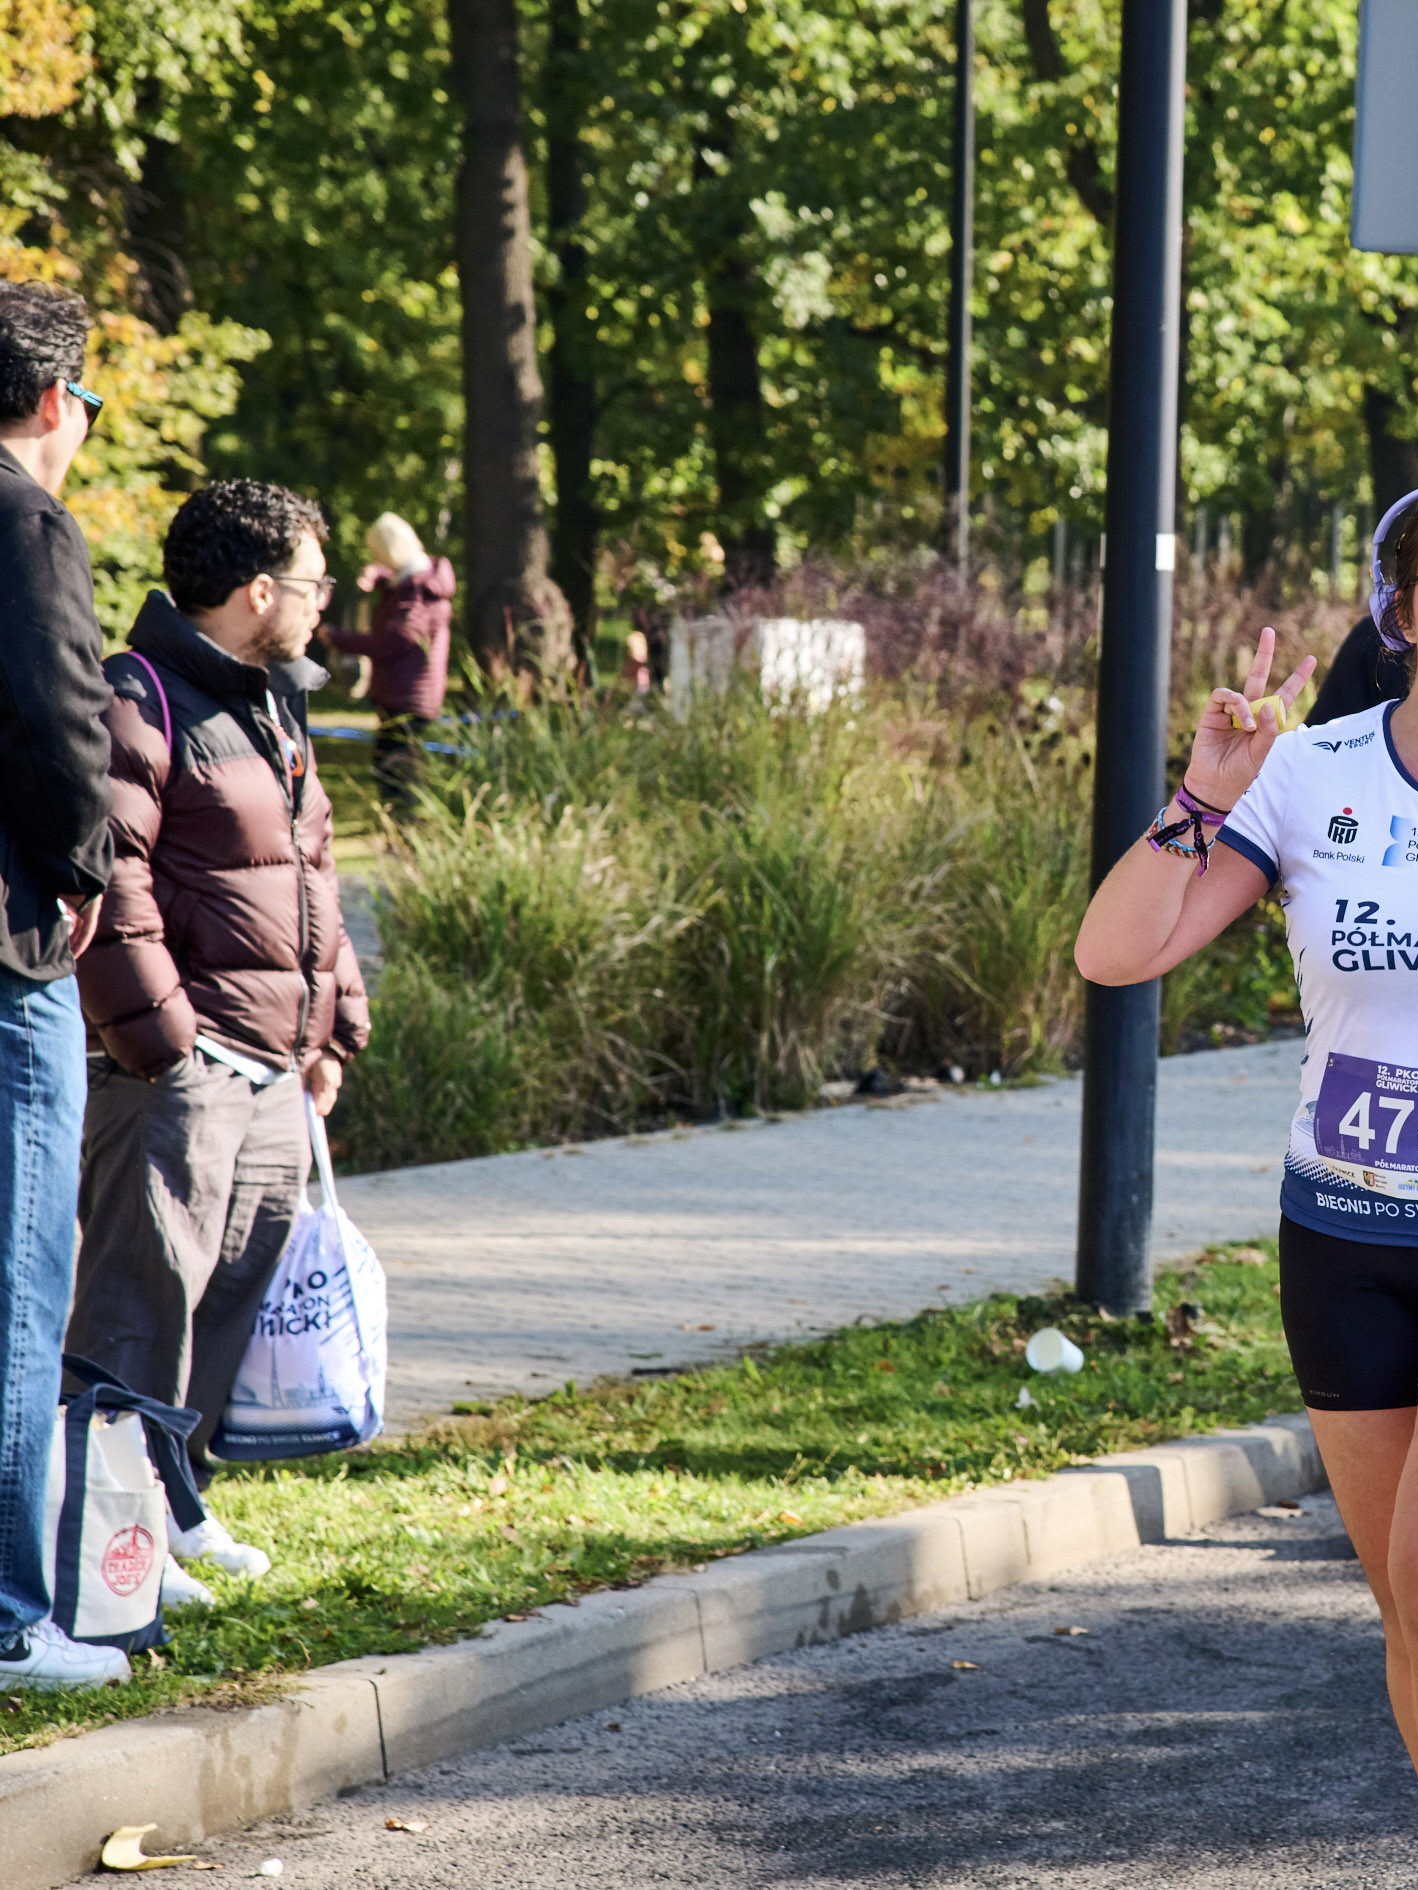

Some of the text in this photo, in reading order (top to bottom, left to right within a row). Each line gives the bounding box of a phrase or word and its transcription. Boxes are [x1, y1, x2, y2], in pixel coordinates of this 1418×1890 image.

[1344, 731, 1375, 746] VENTUS
[1313, 849, 1365, 863] Bank Polski
[1335, 899, 1396, 925] 12.
[1377, 1065, 1391, 1075] 12.
[1316, 1192, 1371, 1215] BIEGNIJ
[1375, 1202, 1399, 1217] PO
